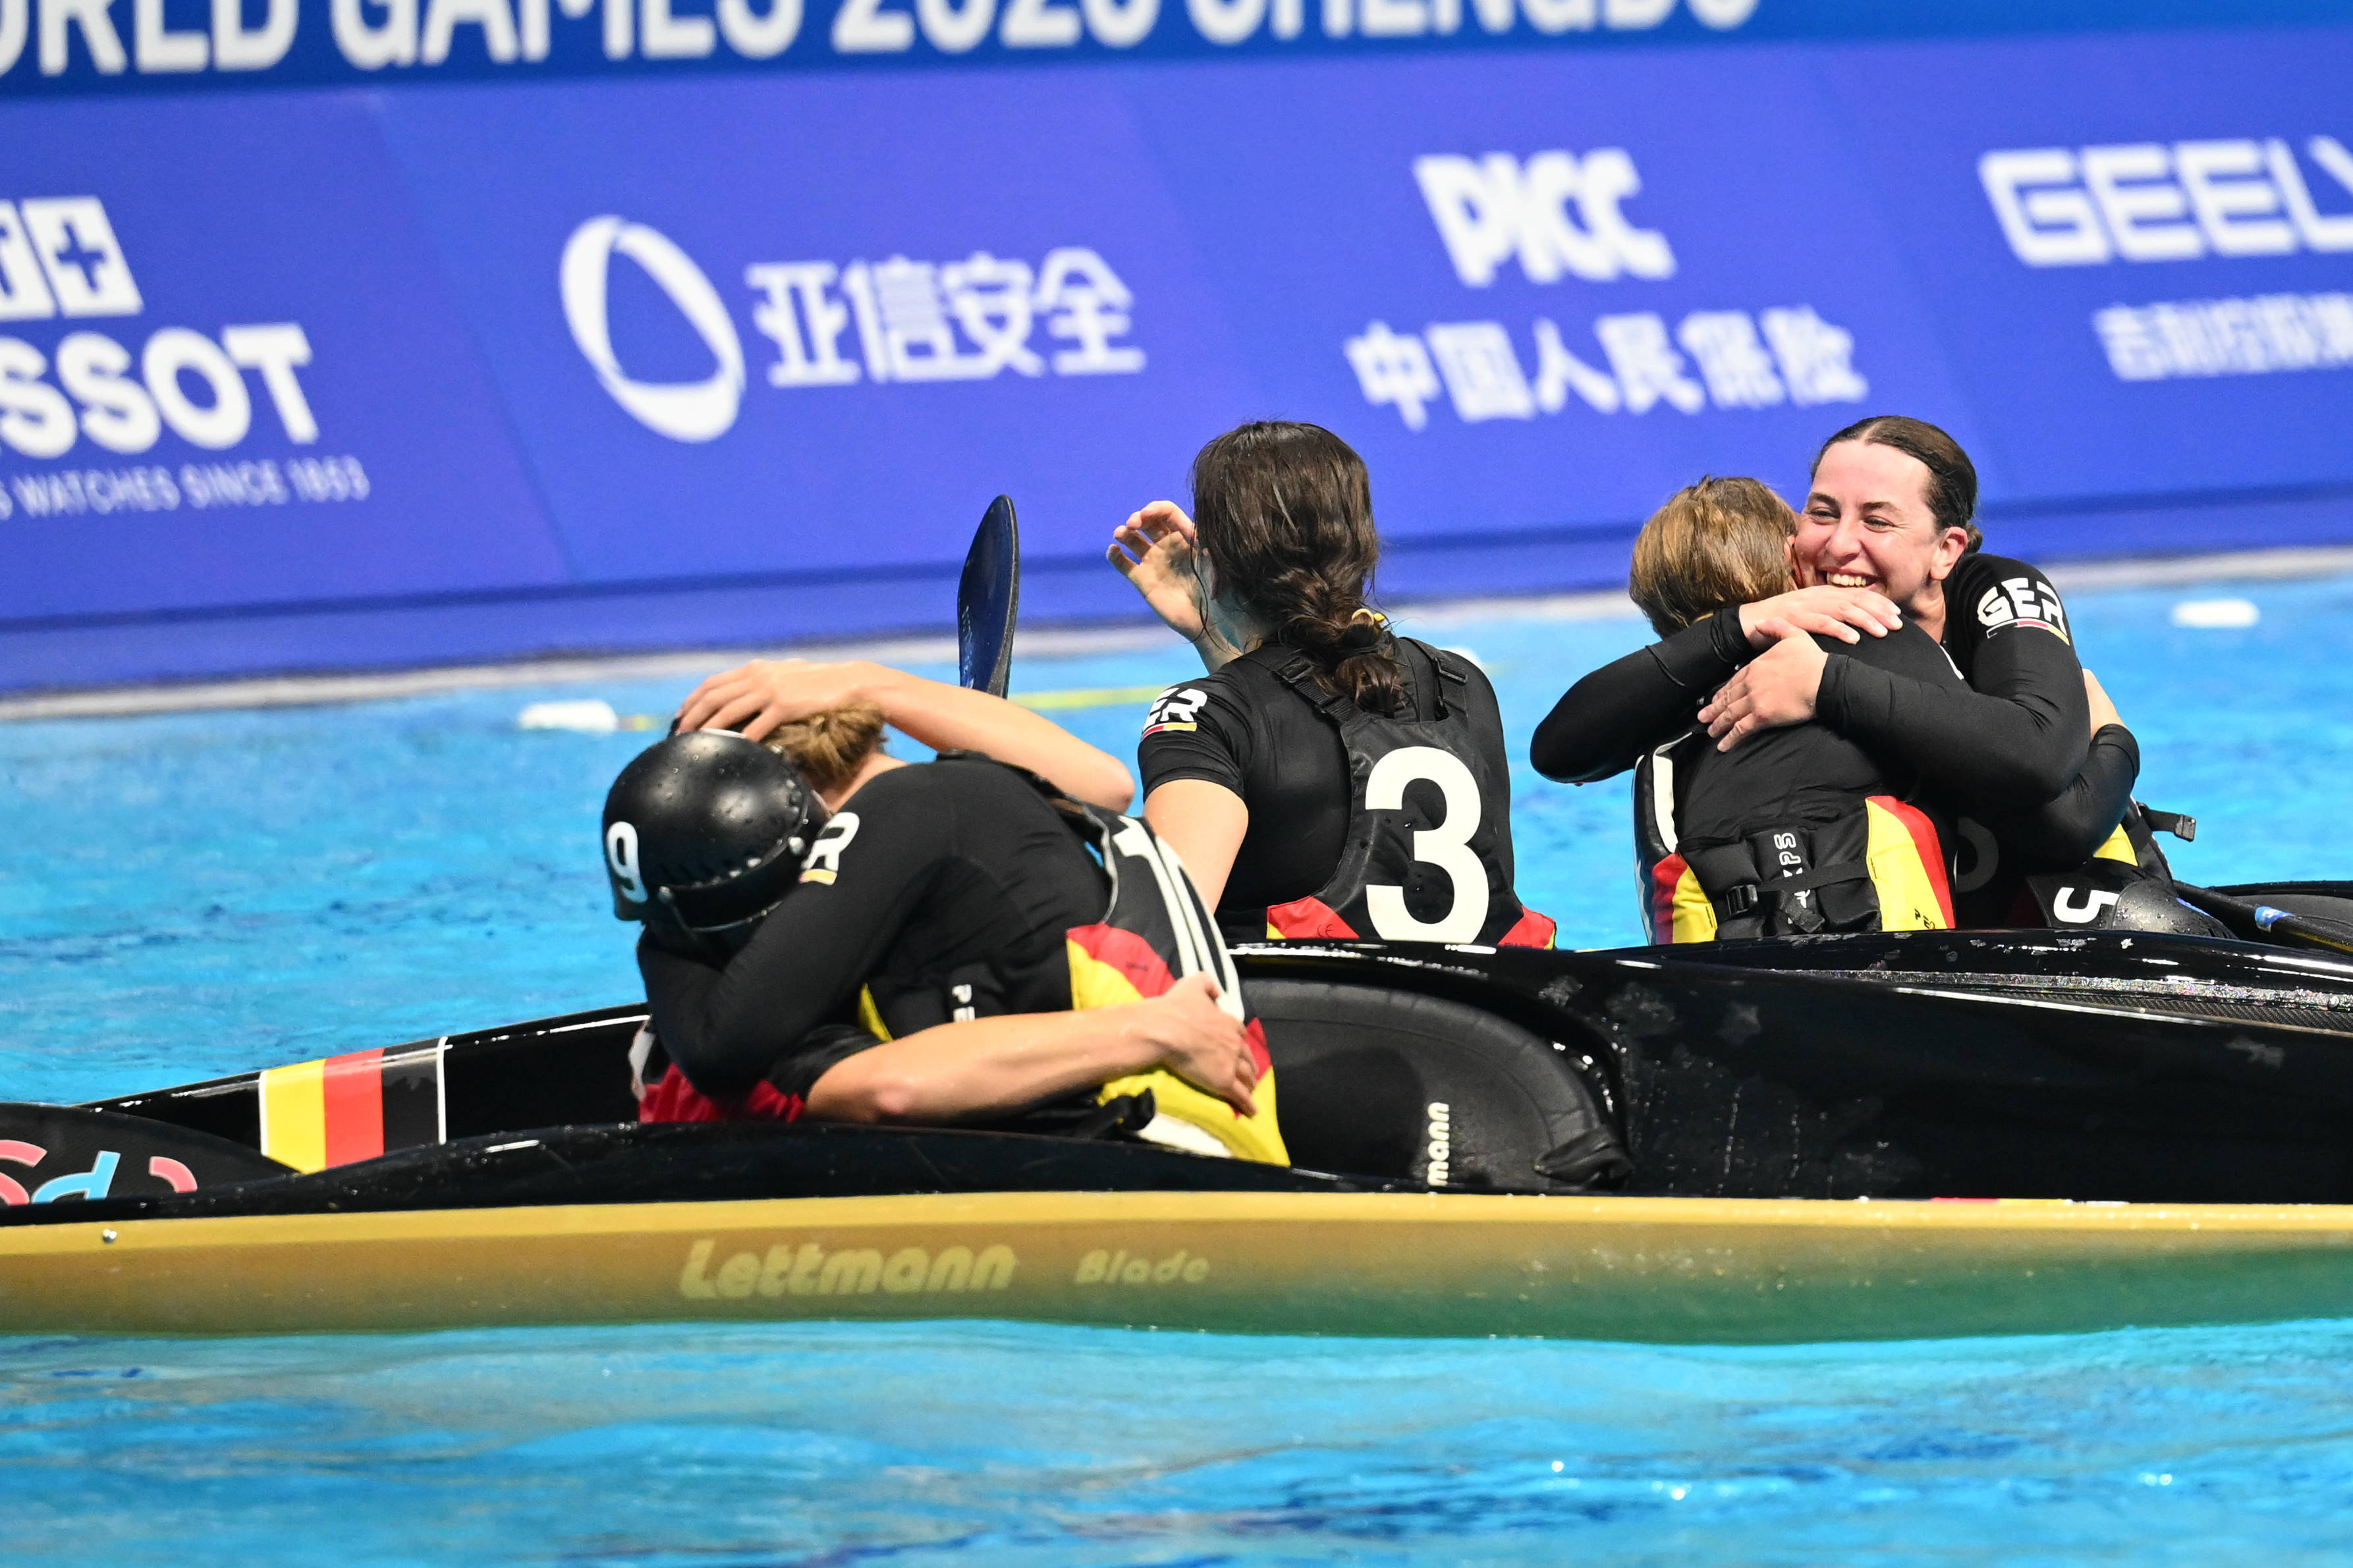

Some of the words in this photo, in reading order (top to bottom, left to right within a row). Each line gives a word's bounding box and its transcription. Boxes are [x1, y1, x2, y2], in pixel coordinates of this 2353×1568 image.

[1414, 150, 1676, 287] PICC
[744, 248, 1146, 387] 亚信安全
[1344, 310, 1873, 432] 中国人民保险
[13, 465, 180, 518] WATCHES
[180, 459, 289, 509] SINCE
[1977, 578, 2068, 637] GER
[607, 821, 648, 904] 9
[1366, 746, 1489, 944] 3
[679, 1239, 1016, 1299] Lettmann
[1075, 1249, 1211, 1284] Blade
